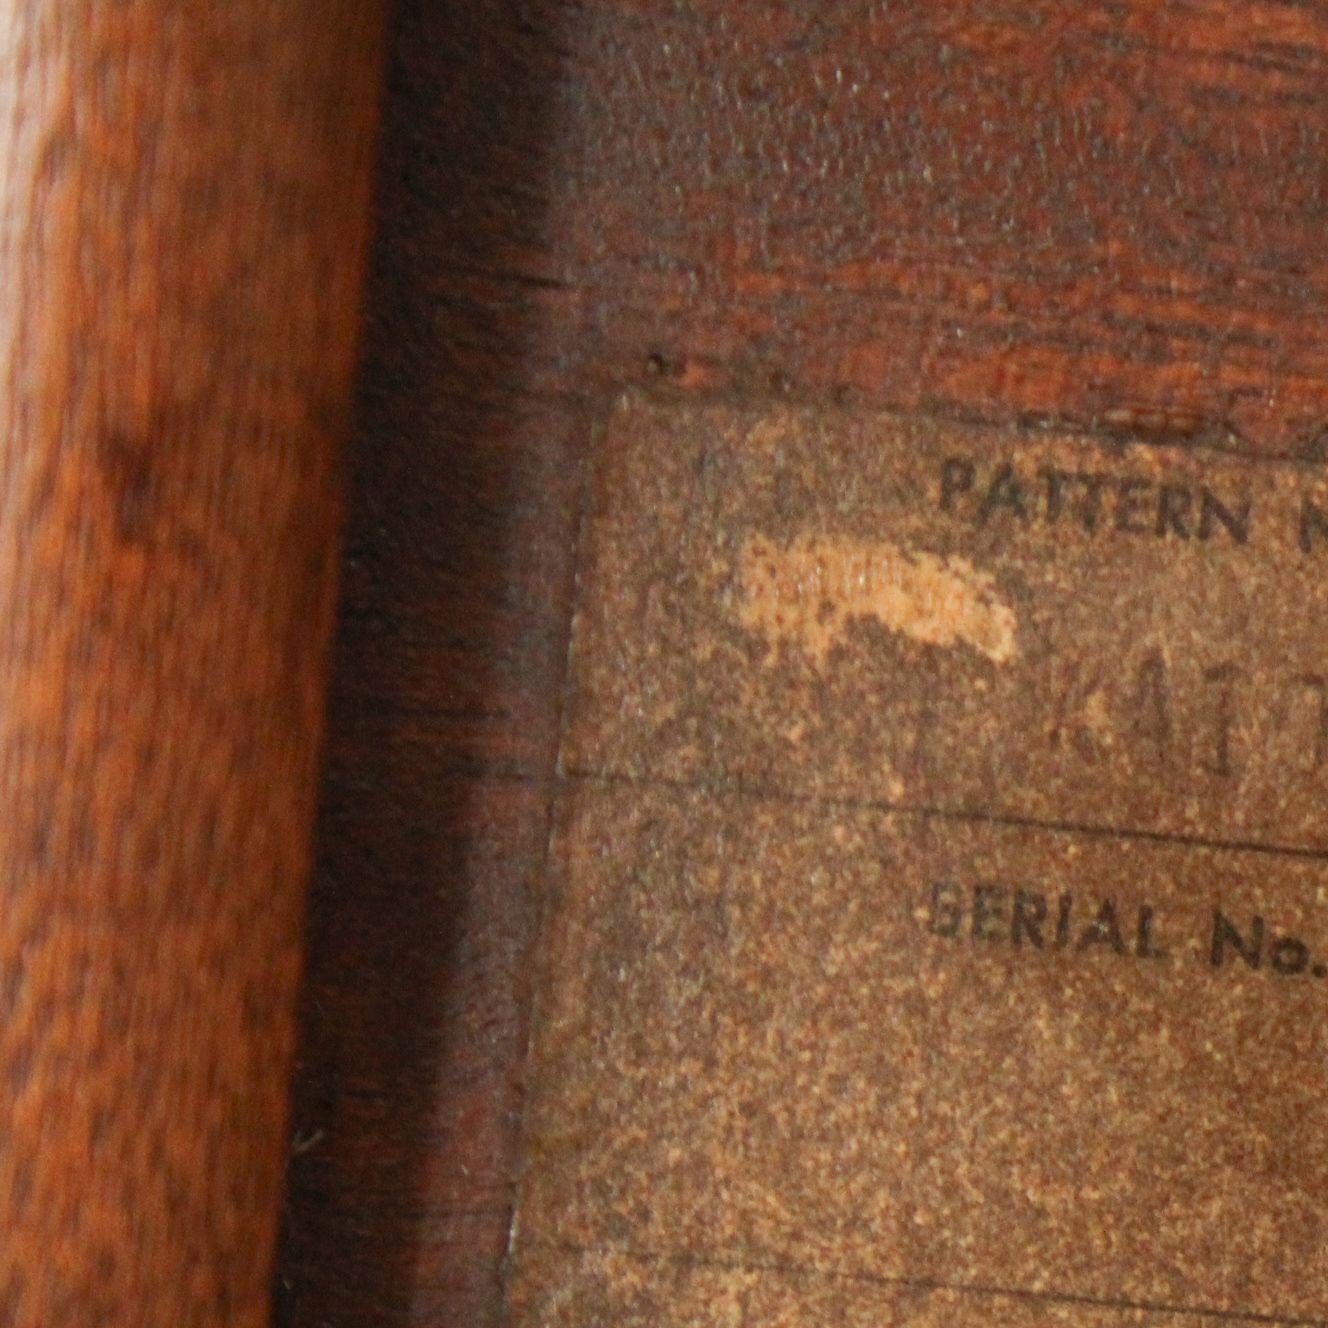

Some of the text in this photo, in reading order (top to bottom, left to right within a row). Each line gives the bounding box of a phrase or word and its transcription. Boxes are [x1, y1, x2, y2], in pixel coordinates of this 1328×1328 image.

[939, 457, 1250, 545] PATTERN
[931, 882, 1328, 979] SERIAL No.
